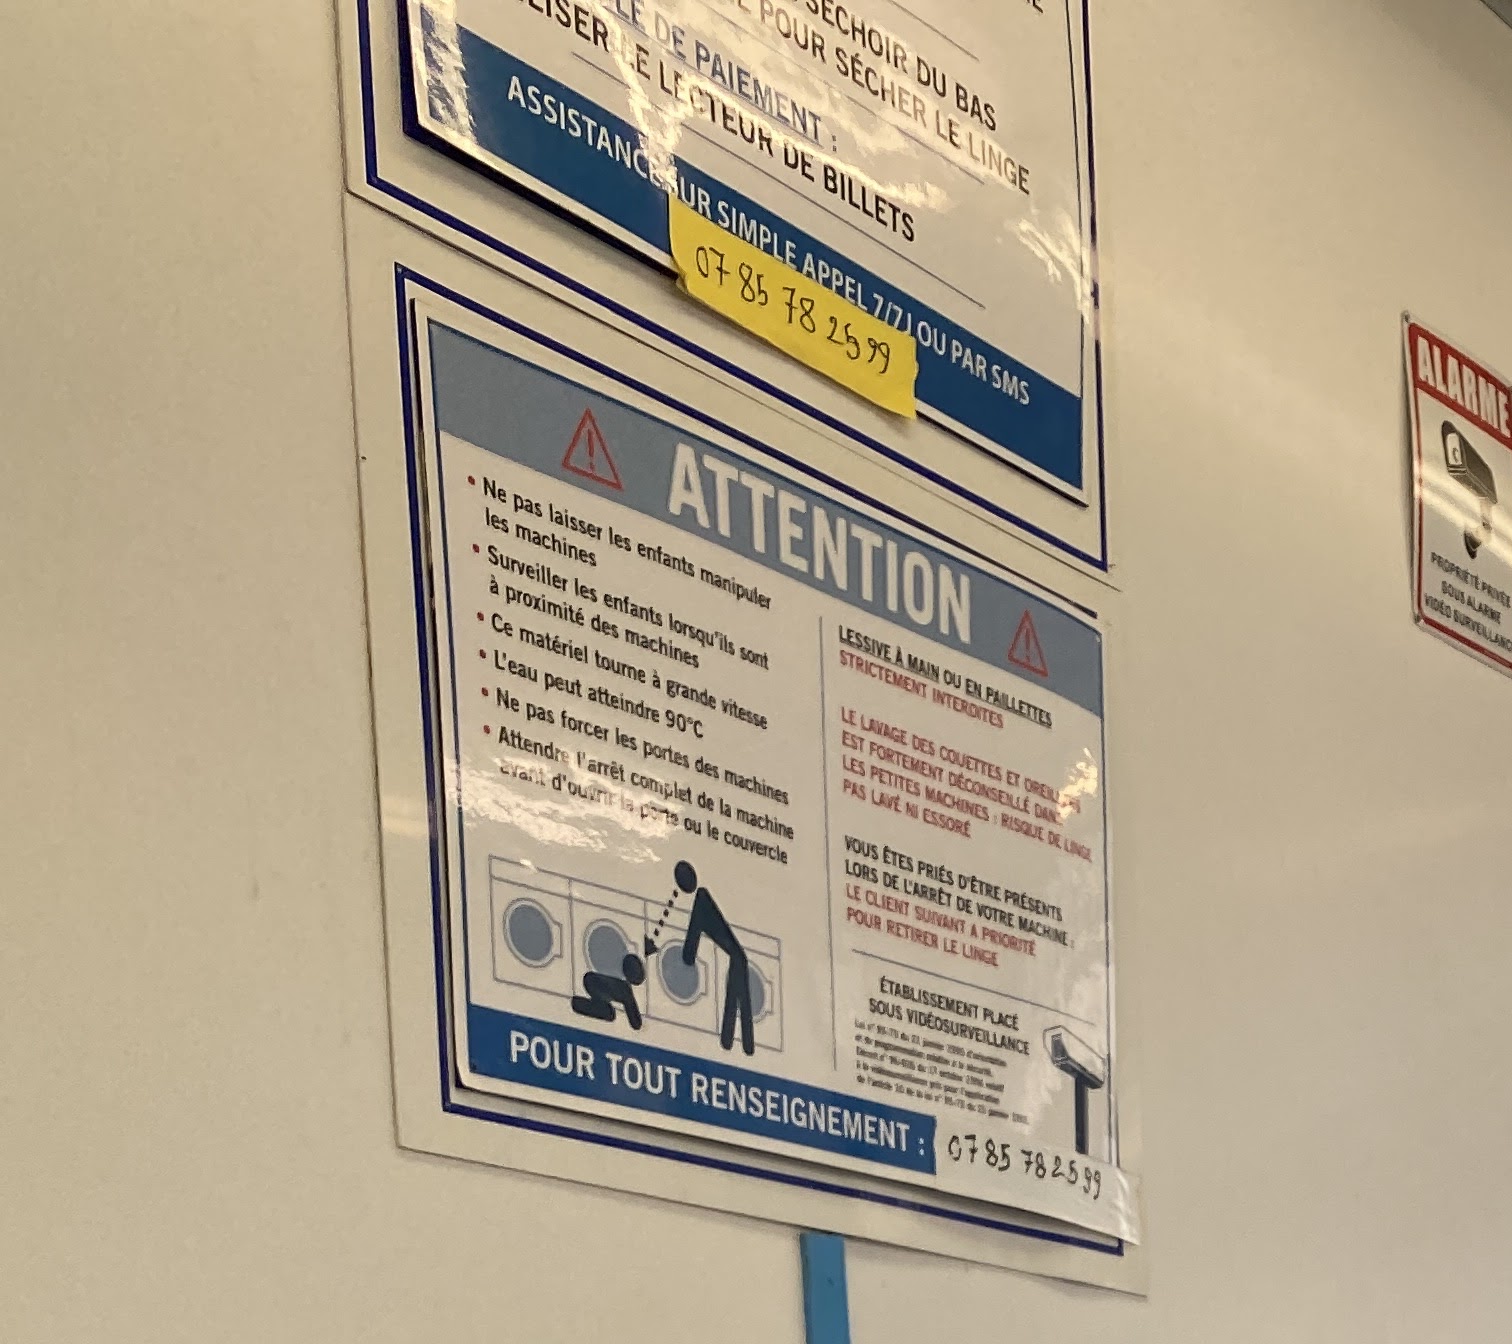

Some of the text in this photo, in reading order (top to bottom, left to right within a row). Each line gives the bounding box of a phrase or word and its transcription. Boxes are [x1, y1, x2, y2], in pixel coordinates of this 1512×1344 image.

[655, 19, 823, 144] DE PAIEMENT
[761, 1, 1030, 195] POUR SÉCHER LE LINGE
[917, 56, 946, 97] DU
[956, 82, 996, 131] BAS
[784, 139, 814, 181] DE
[823, 166, 915, 242] BILLETS
[673, 180, 712, 220] UR
[718, 200, 797, 270] SIMPLE
[802, 252, 867, 311] APPEL
[917, 321, 946, 356] OU
[952, 339, 988, 382] PAR
[992, 364, 1030, 405] SMS
[695, 246, 731, 286] 07
[738, 262, 769, 307] 85
[783, 286, 816, 333] 78
[867, 337, 891, 374] 99
[1417, 334, 1511, 439] ALARME
[482, 476, 771, 610] Ne pas laisser les enfants manipuler
[485, 507, 596, 568] les machines
[669, 441, 972, 646] ATTENTION
[488, 545, 568, 592] Surveiller
[574, 578, 597, 602] les
[604, 593, 662, 627] enfants
[740, 646, 769, 670] sont
[489, 574, 699, 669] à proximité des machines
[1442, 581, 1465, 604] SOUS
[491, 613, 768, 730] Ce matériel tourne à grande vitesse
[494, 650, 704, 738] L'eau peut atteindre 90°C
[838, 624, 891, 662] LESSIVE
[908, 653, 940, 683] MAIN
[944, 669, 961, 689] OU
[965, 677, 982, 699] EN
[986, 686, 1053, 728] PAILLETTES
[840, 650, 1004, 729] STRICTEMENT INTERDITES
[496, 688, 789, 805] Ne pas forcer les portes des machines
[499, 726, 569, 763] Attendre
[578, 751, 625, 783] l'arrêt
[631, 772, 692, 806] complet
[698, 792, 714, 812] de
[719, 799, 731, 818] la
[736, 807, 794, 841] machine
[845, 835, 878, 861] VOUS
[883, 846, 913, 872] ÊTES
[917, 860, 954, 887] PRIÉS
[1004, 887, 1063, 921] PRÉSENTS
[845, 859, 878, 884] LORS
[883, 871, 899, 891] DE
[956, 895, 973, 915] DE
[977, 904, 1014, 928] VOTRE
[1018, 915, 1068, 946] MACHINE
[869, 998, 1030, 1056] SOUS VIDÉOSURVEILLANCE
[880, 975, 1020, 1031] ÉTABLISSEMENT PLACÉ
[510, 1030, 595, 1080] POUR
[606, 1052, 681, 1098] TOUT
[692, 1072, 910, 1152] RENSEIGNEMENT
[948, 1134, 978, 1163] 07
[986, 1139, 1010, 1171] 85
[1021, 1149, 1047, 1179] 78
